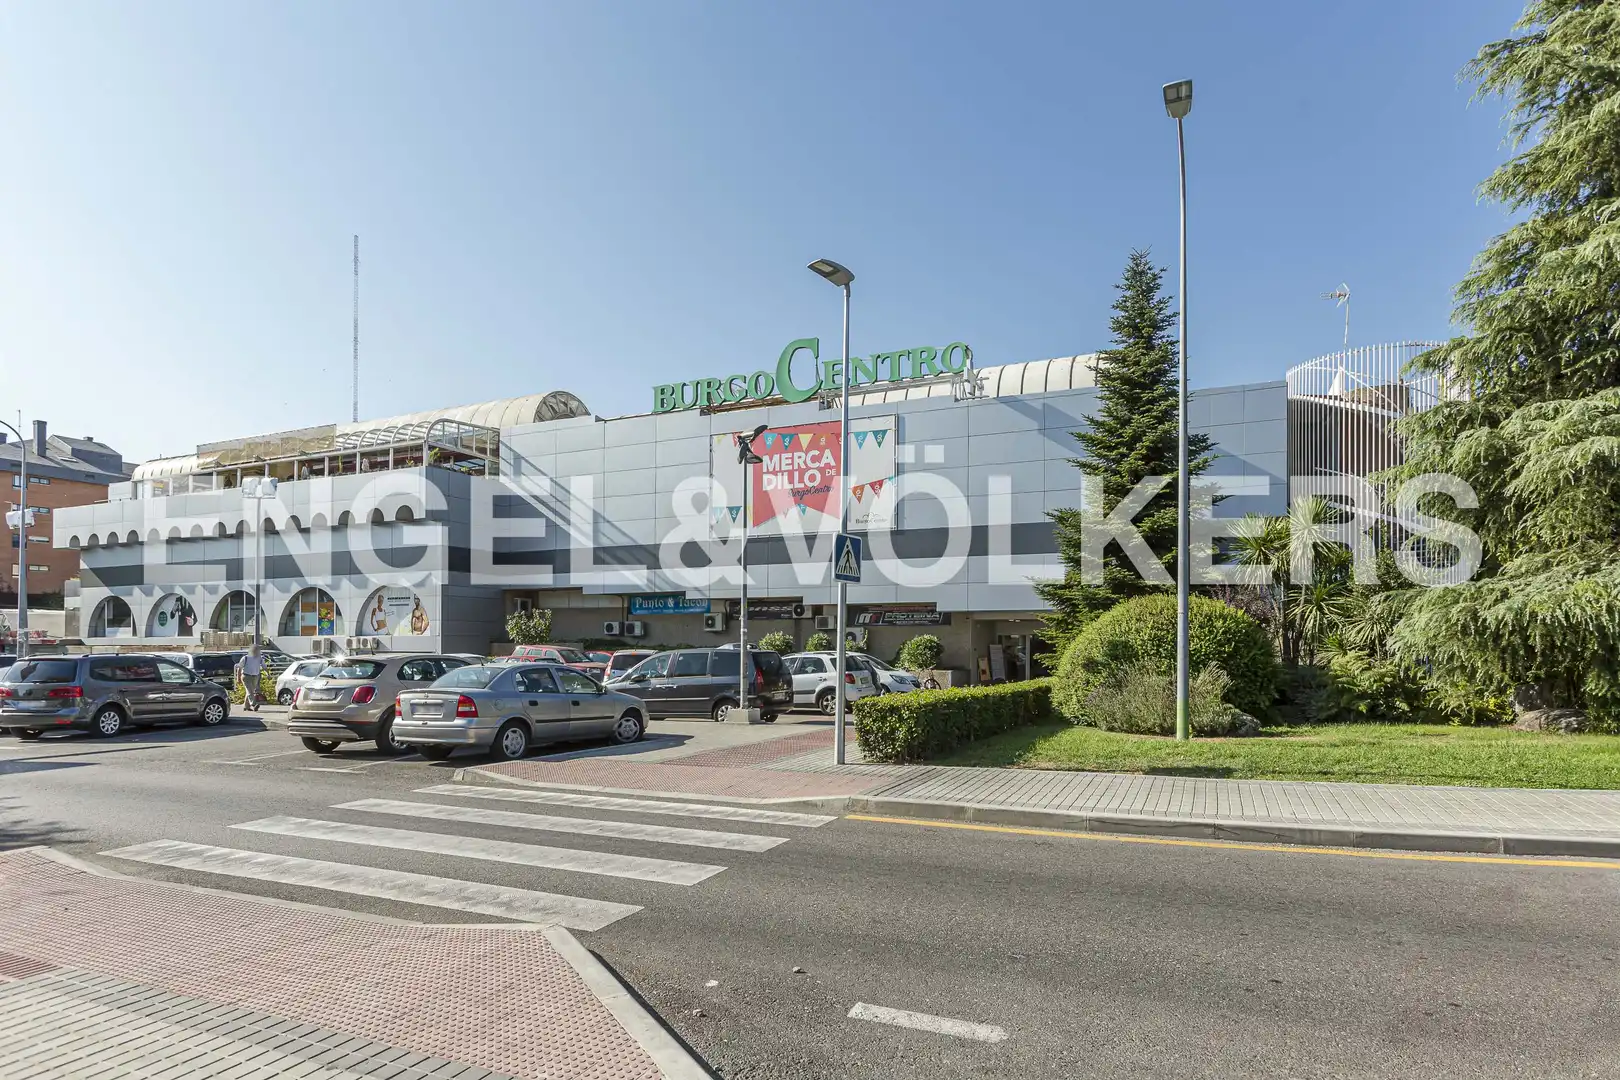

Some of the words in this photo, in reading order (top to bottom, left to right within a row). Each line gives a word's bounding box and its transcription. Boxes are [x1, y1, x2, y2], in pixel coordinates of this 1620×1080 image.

[762, 449, 836, 472] MERCA
[762, 469, 821, 491] DILLO
[635, 597, 665, 609] Punto
[667, 597, 675, 608] &
